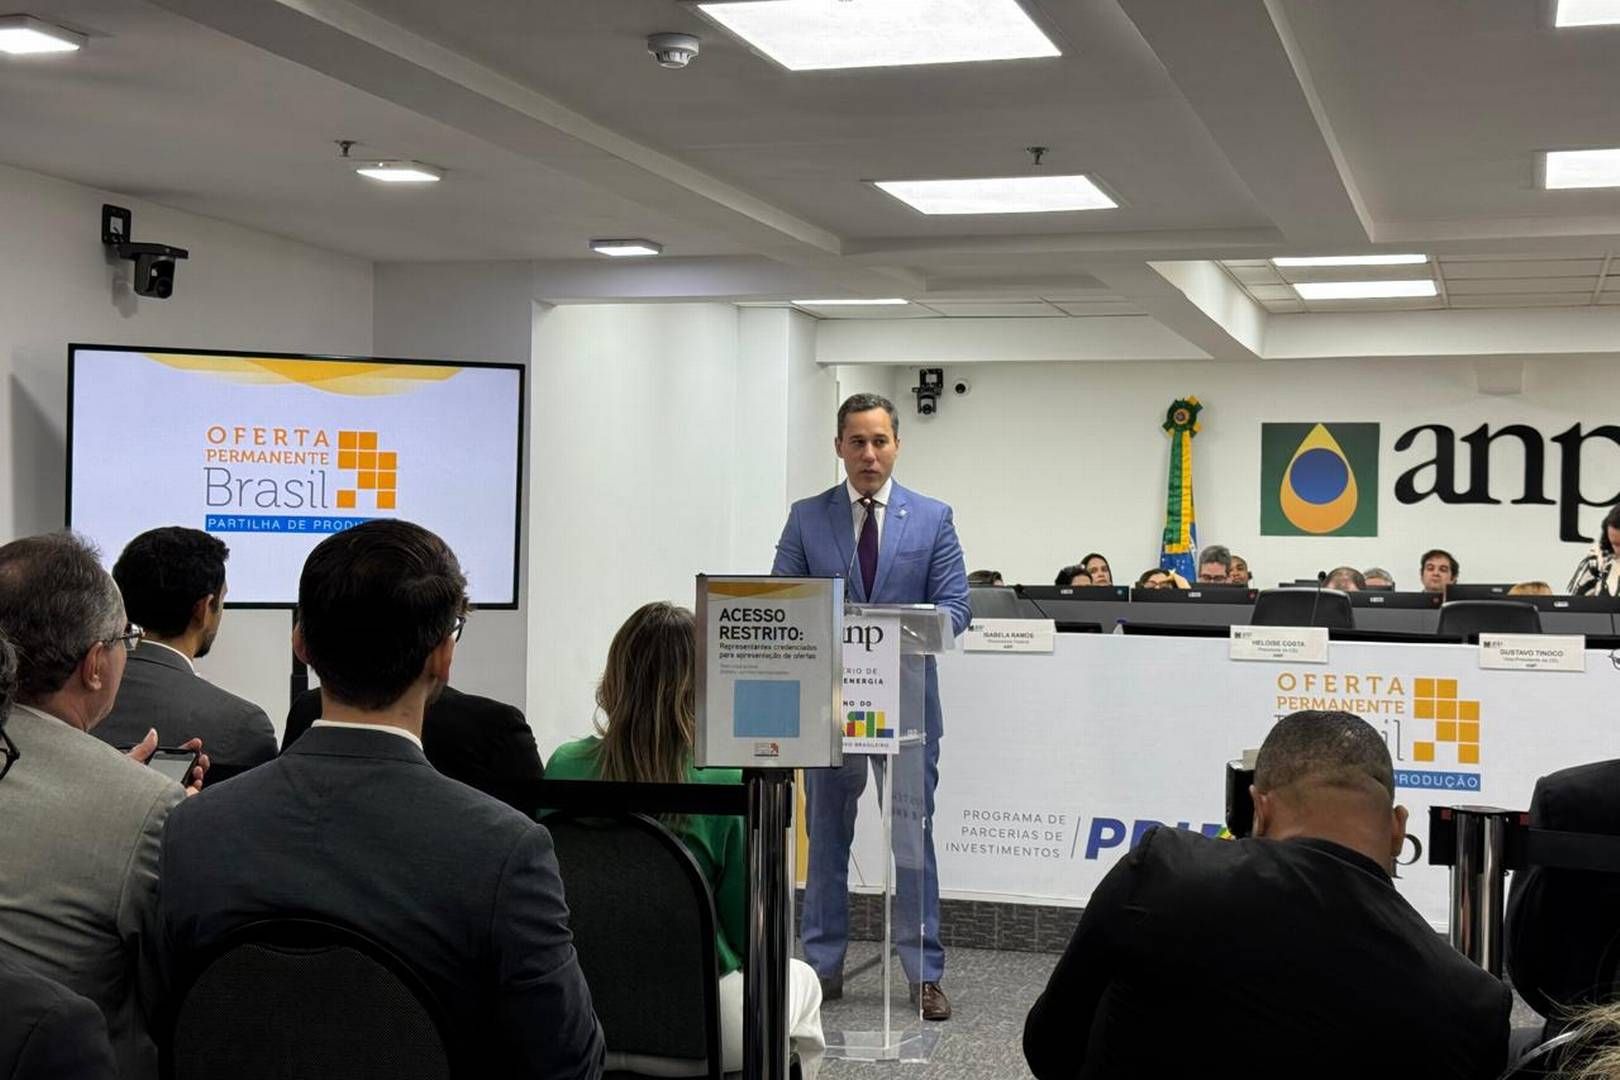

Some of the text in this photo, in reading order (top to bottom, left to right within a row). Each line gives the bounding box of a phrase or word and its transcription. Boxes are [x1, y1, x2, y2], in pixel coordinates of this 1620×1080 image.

[207, 426, 330, 447] OFERTA
[206, 449, 329, 465] PERMANENTE
[204, 466, 329, 509] Brasil
[1394, 421, 1620, 544] anp
[207, 518, 281, 530] PARTILHA
[287, 519, 306, 530] DE
[719, 608, 786, 622] ACESSO
[719, 626, 804, 641] RESTRITO:
[719, 642, 818, 651] Representantes credenciados
[1500, 648, 1564, 657] GUSTAVO TINOCO
[719, 652, 734, 660] para
[866, 667, 878, 675] DE
[1277, 672, 1405, 695] OFERTA
[1276, 696, 1405, 714] PERMANENTE
[963, 810, 1066, 825] PROGRAMA DE
[961, 827, 1063, 842] PARCERIAS DE
[945, 842, 1061, 859] INVESTIMENTOS
